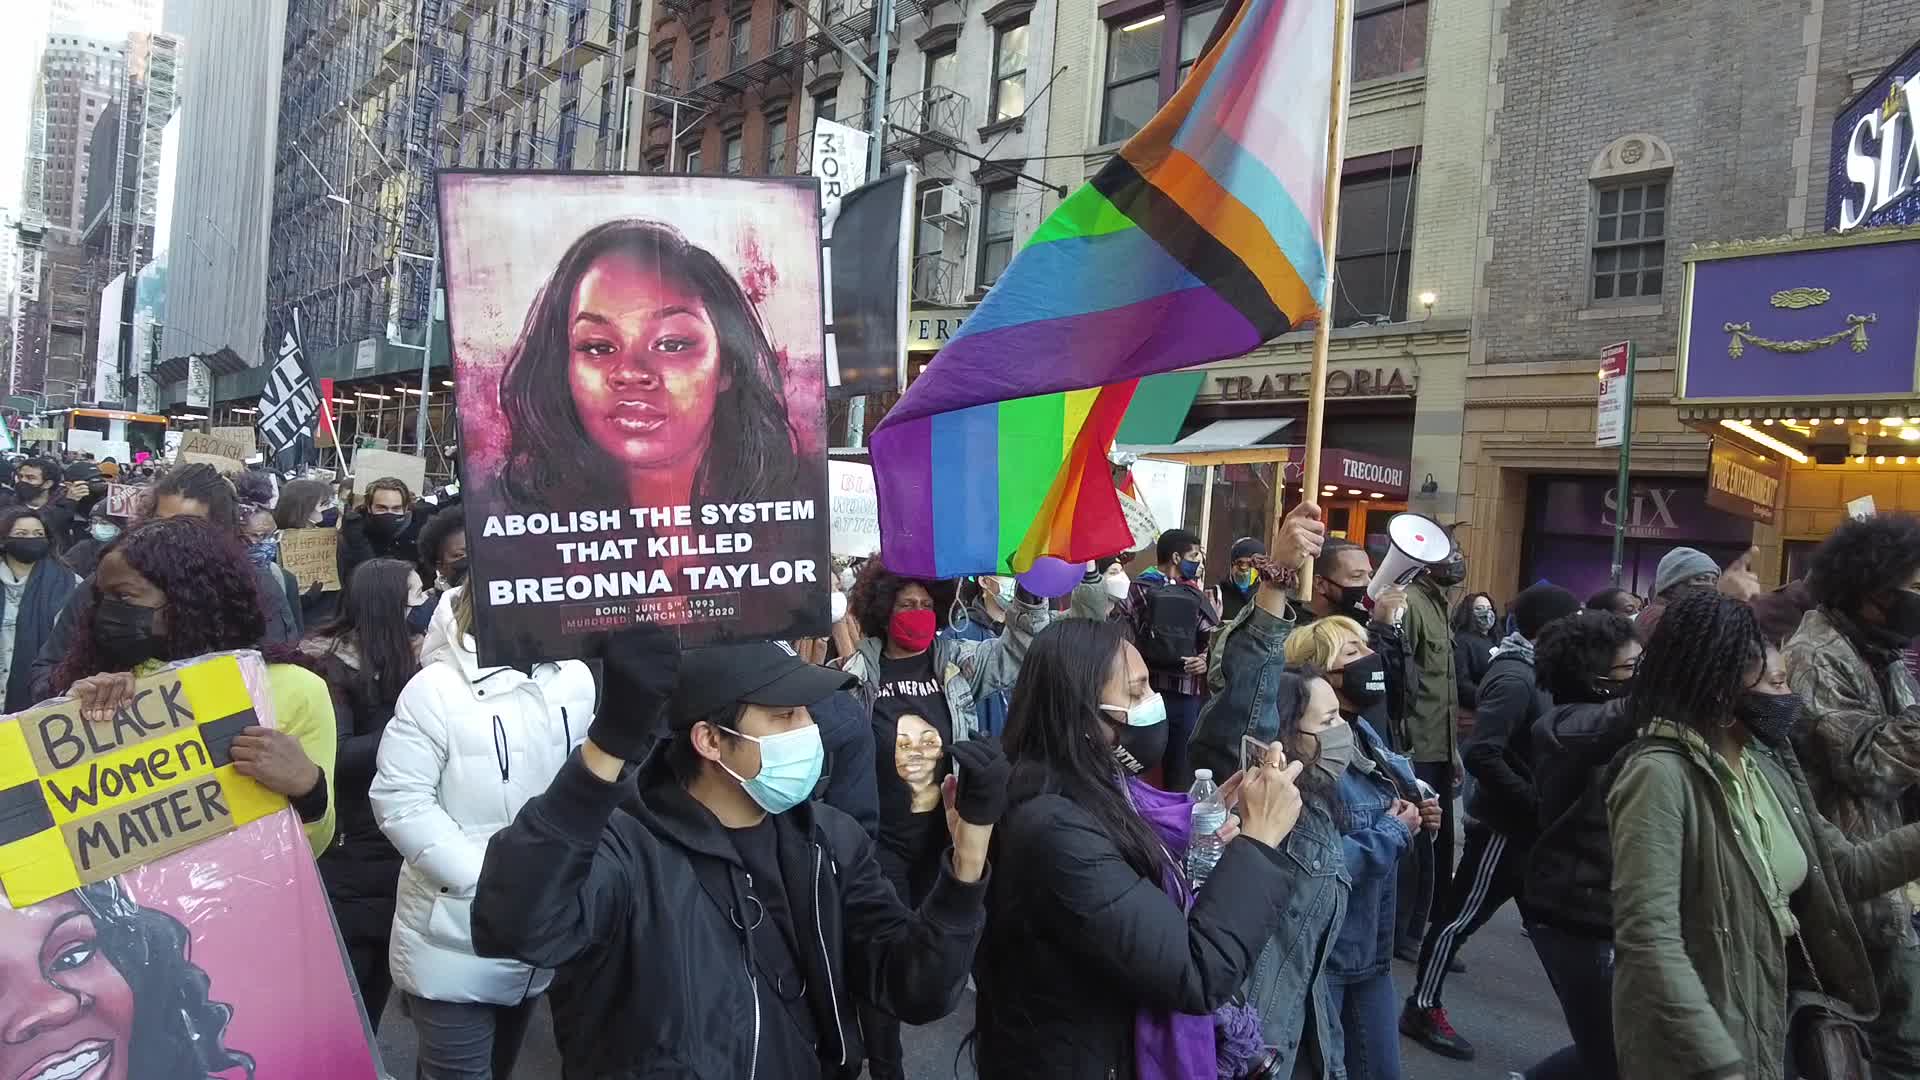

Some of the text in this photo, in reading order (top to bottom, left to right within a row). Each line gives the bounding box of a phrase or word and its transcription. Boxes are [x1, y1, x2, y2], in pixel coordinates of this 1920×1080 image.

[817, 133, 841, 204] MOR
[908, 318, 963, 339] ER
[1343, 458, 1403, 487] TRECOLORI
[483, 500, 815, 536] ABOLISH THE SYSTEM
[1601, 488, 1679, 529] SIX
[557, 533, 753, 564] THAT KILLED
[488, 559, 816, 605] BREONNA TAYLOR
[595, 606, 631, 616] BORN:
[635, 603, 662, 613] JUNE
[689, 600, 715, 609] 1993
[636, 612, 676, 623] MARCH
[709, 607, 735, 617] 2020
[38, 680, 195, 769] BLACK
[77, 780, 229, 870] MATTER
